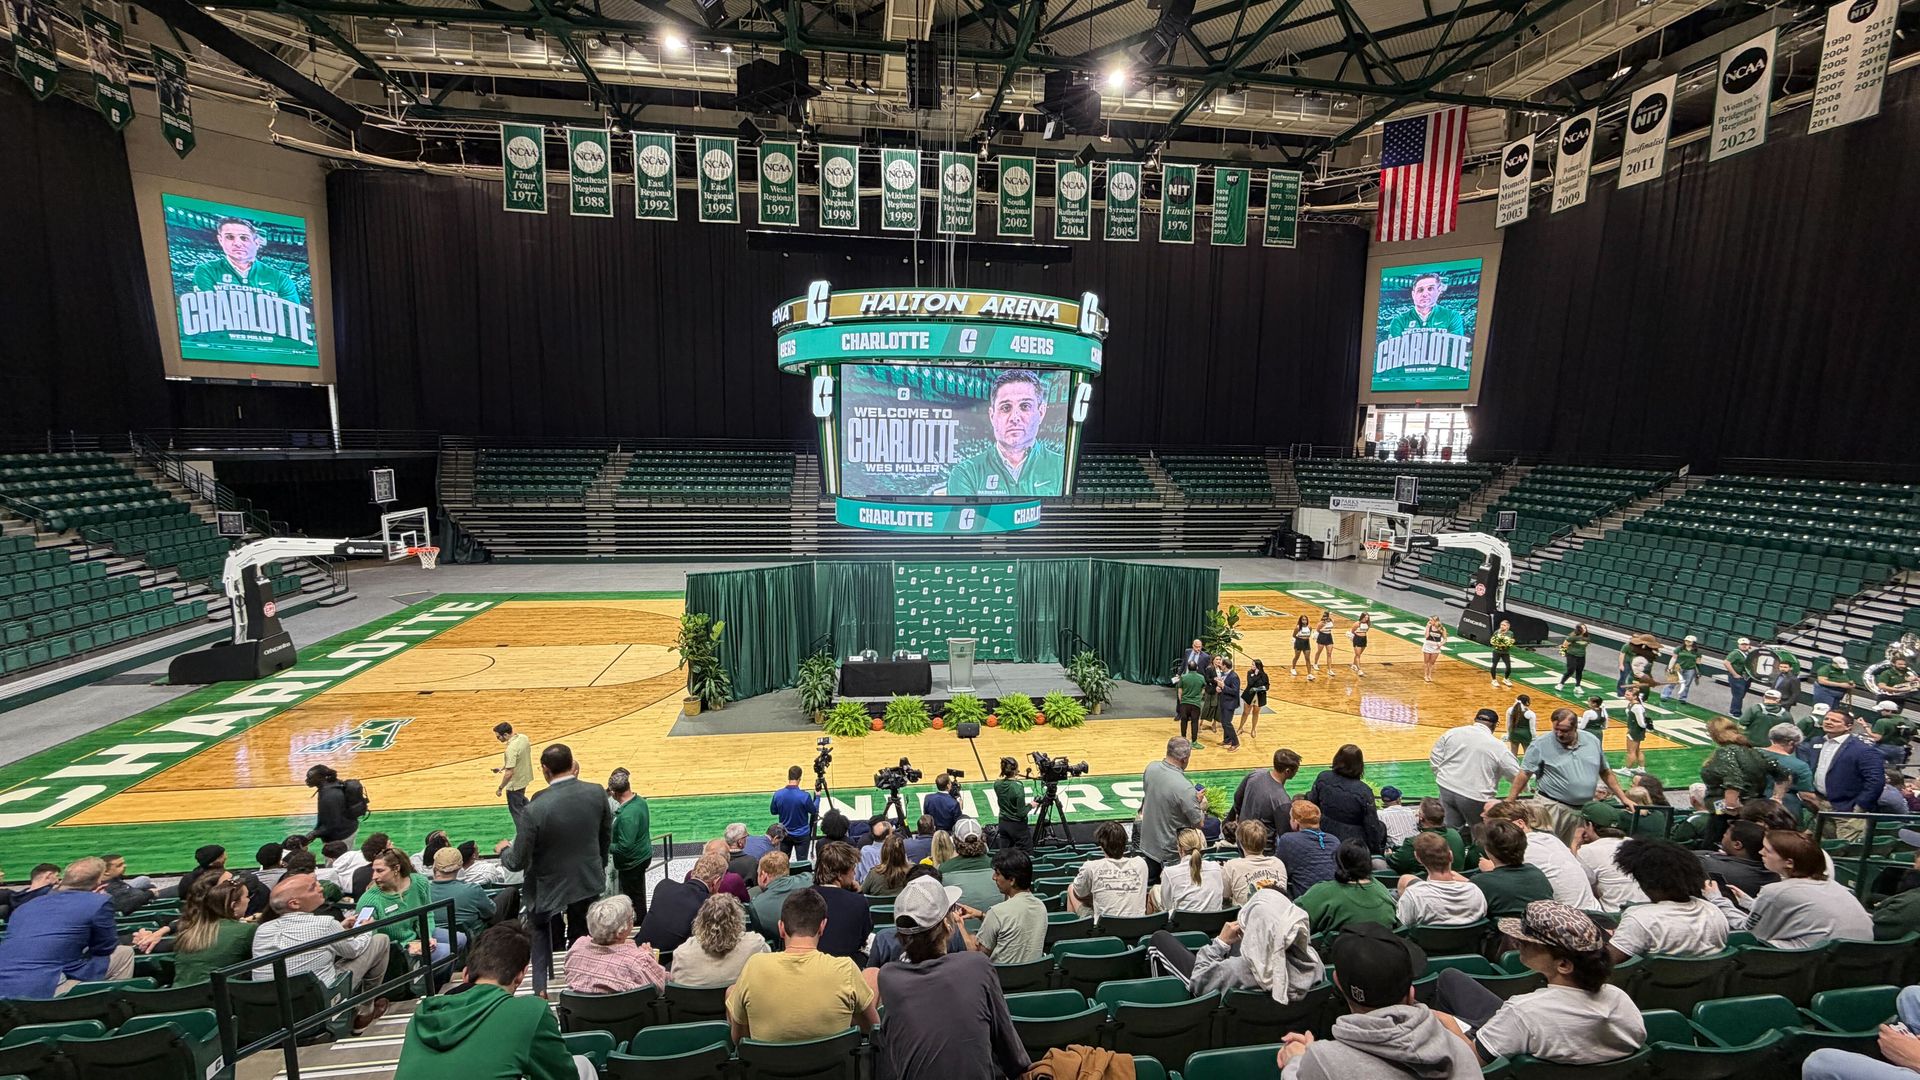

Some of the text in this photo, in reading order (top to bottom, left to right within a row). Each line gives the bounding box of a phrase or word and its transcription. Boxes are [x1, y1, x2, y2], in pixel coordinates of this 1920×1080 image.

[1850, 4, 1874, 20] NIT
[1865, 17, 1893, 33] 2012
[1826, 34, 1851, 48] 1990
[1863, 29, 1891, 45] 2013
[1823, 46, 1849, 60] 2004
[1861, 41, 1889, 57] 2014
[1821, 57, 1848, 71] 2005
[1859, 53, 1887, 69] 2016
[1725, 59, 1765, 84] NCAA
[1819, 69, 1845, 83] 2006
[1857, 65, 1883, 80] 2019
[1817, 81, 1843, 95] 2007
[1854, 77, 1882, 92] 2021
[1723, 93, 1760, 113] Women's
[1815, 93, 1841, 106] 2008
[1719, 102, 1761, 124] Bridgeport
[1813, 105, 1839, 117] 2010
[1635, 107, 1662, 128] NIT
[1721, 114, 1756, 133] Regional
[1811, 116, 1836, 128] 2011
[1563, 128, 1589, 146] NCAA
[1718, 127, 1755, 151] 2022
[509, 146, 538, 157] NCAA
[576, 152, 603, 162] NCAA
[642, 156, 668, 167] NCAA
[705, 160, 730, 169] NCAA
[1505, 153, 1528, 168] NCAA
[1626, 157, 1654, 176] 2011
[765, 163, 791, 172] NCAA
[827, 167, 851, 176] NCAA
[513, 170, 536, 180] Final
[573, 176, 607, 184] Southeast
[889, 170, 913, 179] NCAA
[946, 173, 969, 183] NCAA
[515, 181, 535, 190] Four
[648, 180, 663, 188] East
[711, 183, 726, 191] East
[1005, 176, 1028, 186] NCAA
[1063, 181, 1085, 190] NCAA
[1112, 182, 1134, 191] NCAA
[1502, 177, 1528, 191] Women's
[576, 185, 606, 194] Regional
[641, 188, 671, 198] Regional
[832, 190, 847, 198] East
[1169, 185, 1190, 195] NIT
[1501, 188, 1527, 201] Midwest
[512, 191, 537, 202] 1977
[579, 196, 604, 207] 1988
[704, 192, 733, 201] Regional
[764, 193, 794, 202] Regional
[1557, 193, 1580, 209] 2009
[644, 200, 669, 210] 1992
[708, 203, 732, 213] 1995
[826, 199, 854, 208] Regional
[888, 201, 915, 209] Regional
[1500, 195, 1526, 211] Regional
[766, 205, 790, 215] 1997
[828, 210, 851, 220] 1998
[890, 211, 912, 221] 1999
[1003, 207, 1030, 216] Regional
[1167, 206, 1190, 215] Finals
[1501, 210, 1523, 222] 2003
[946, 215, 968, 225] 2001
[1005, 218, 1027, 227] 2002
[1111, 215, 1134, 223] Regional
[1061, 225, 1084, 235] 2004
[1111, 226, 1134, 236] 2005
[1168, 221, 1187, 230] 1976
[214, 284, 278, 297] WELCOME TO
[807, 280, 829, 324] C
[860, 293, 1059, 320] HALTON ARENA
[180, 290, 313, 346] CHARLOTTE
[772, 305, 789, 327] ENA
[1081, 292, 1098, 333] C
[842, 332, 929, 350] CHARLOTTE
[1010, 336, 1053, 355] 49ERS
[1376, 333, 1470, 373] CHARLOTTE
[813, 376, 833, 417] C
[1073, 384, 1091, 422] C
[854, 407, 952, 418] WELCOME TO
[848, 418, 959, 463] CHARLOTTE
[865, 464, 939, 472] WES MILLER
[859, 508, 933, 527] CHARLOTTE
[1014, 505, 1041, 524] CHARL
[0, 601, 494, 829] CHARLOTTE
